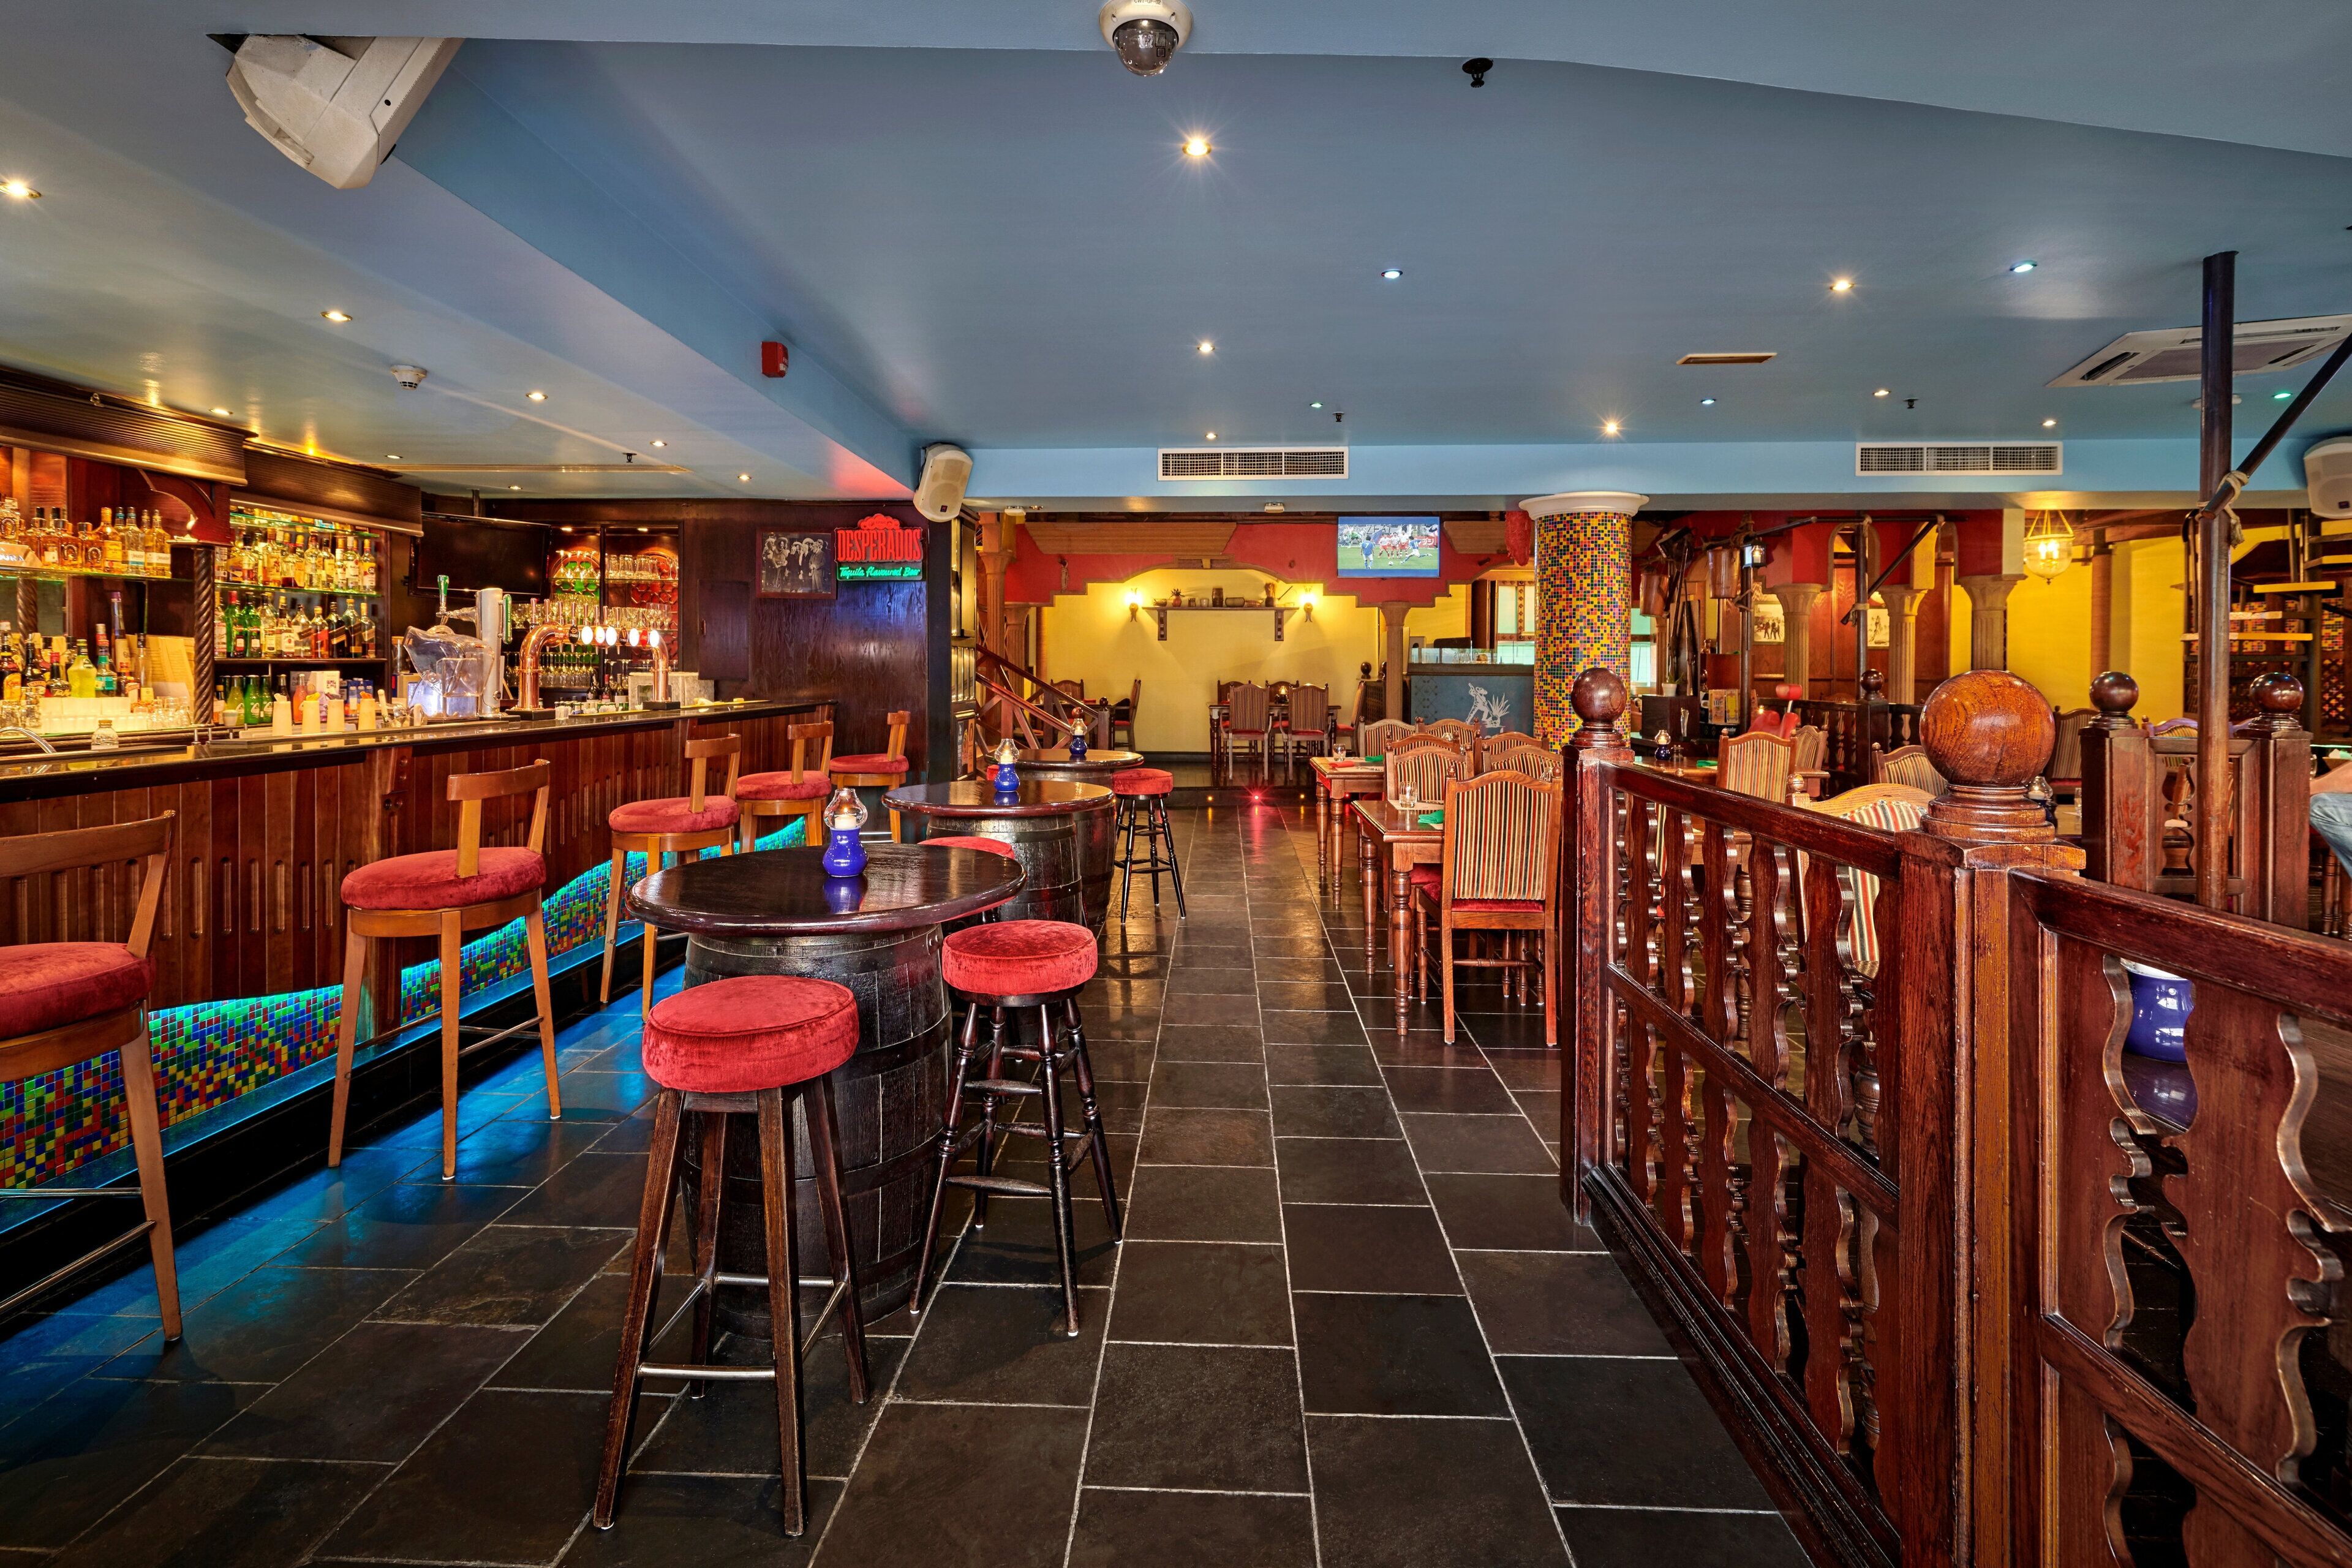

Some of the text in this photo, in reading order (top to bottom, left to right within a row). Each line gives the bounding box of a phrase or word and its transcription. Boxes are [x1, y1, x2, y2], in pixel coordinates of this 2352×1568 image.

[837, 529, 922, 562] DESPERADOS
[840, 565, 921, 579] Tequila flavoured Beer
